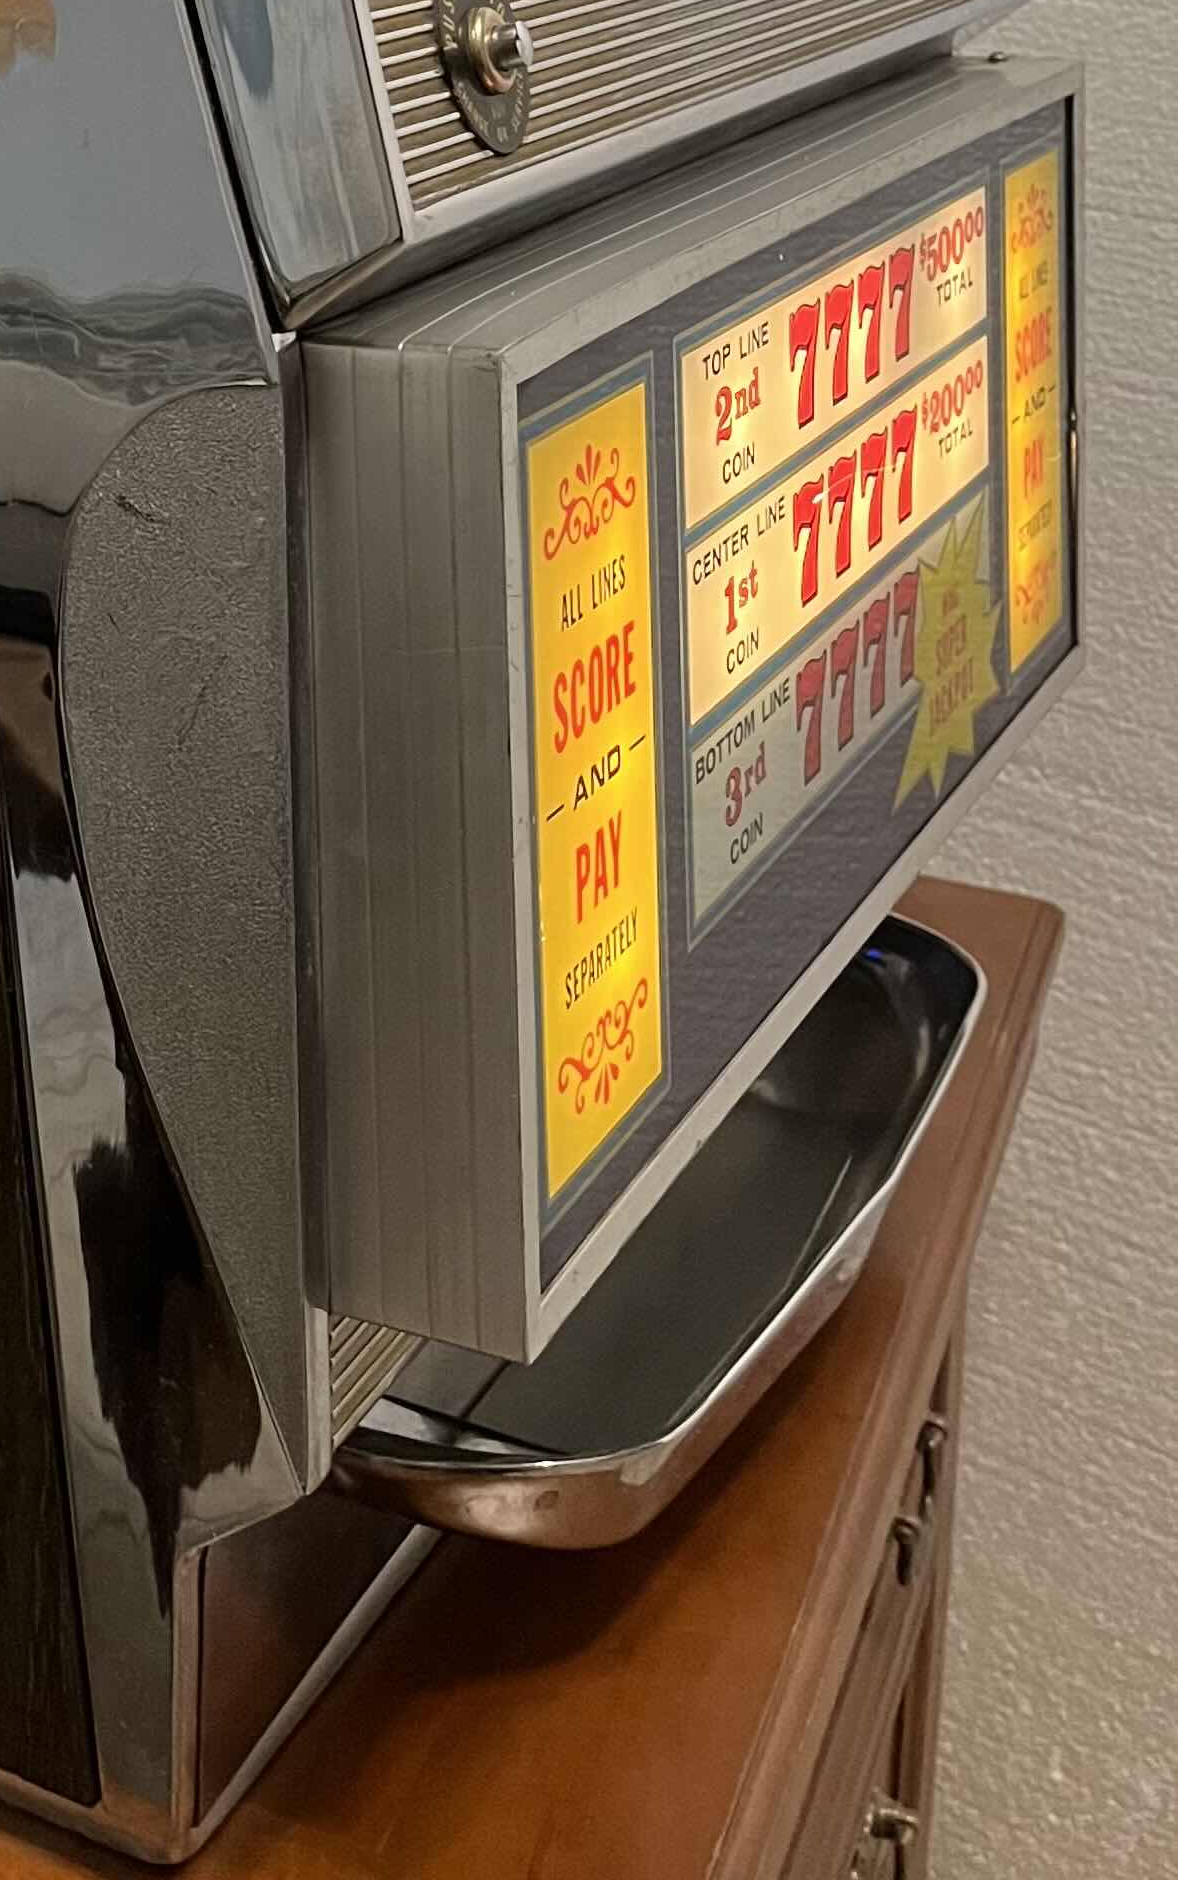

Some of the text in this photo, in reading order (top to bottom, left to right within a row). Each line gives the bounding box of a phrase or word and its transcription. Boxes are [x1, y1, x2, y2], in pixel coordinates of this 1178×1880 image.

[936, 266, 973, 307] TOTAL
[702, 343, 731, 380] TOP
[739, 321, 770, 359] LINE
[714, 365, 761, 446] 2nd
[938, 416, 973, 458] TOTAL
[722, 441, 756, 484] COIN
[692, 523, 749, 585] CENTER
[756, 496, 786, 537] LINE
[561, 553, 626, 632] ALL LINES
[724, 560, 759, 636] 1st
[553, 619, 637, 755] SCORE
[726, 627, 760, 674] COIN
[695, 709, 755, 785] BOTTOM
[760, 675, 791, 724] LINE
[573, 743, 622, 811] AND
[725, 740, 767, 827] 3rd
[575, 808, 623, 925] PAY
[730, 811, 764, 865] COIN
[565, 905, 639, 1011] SEPARATELY
